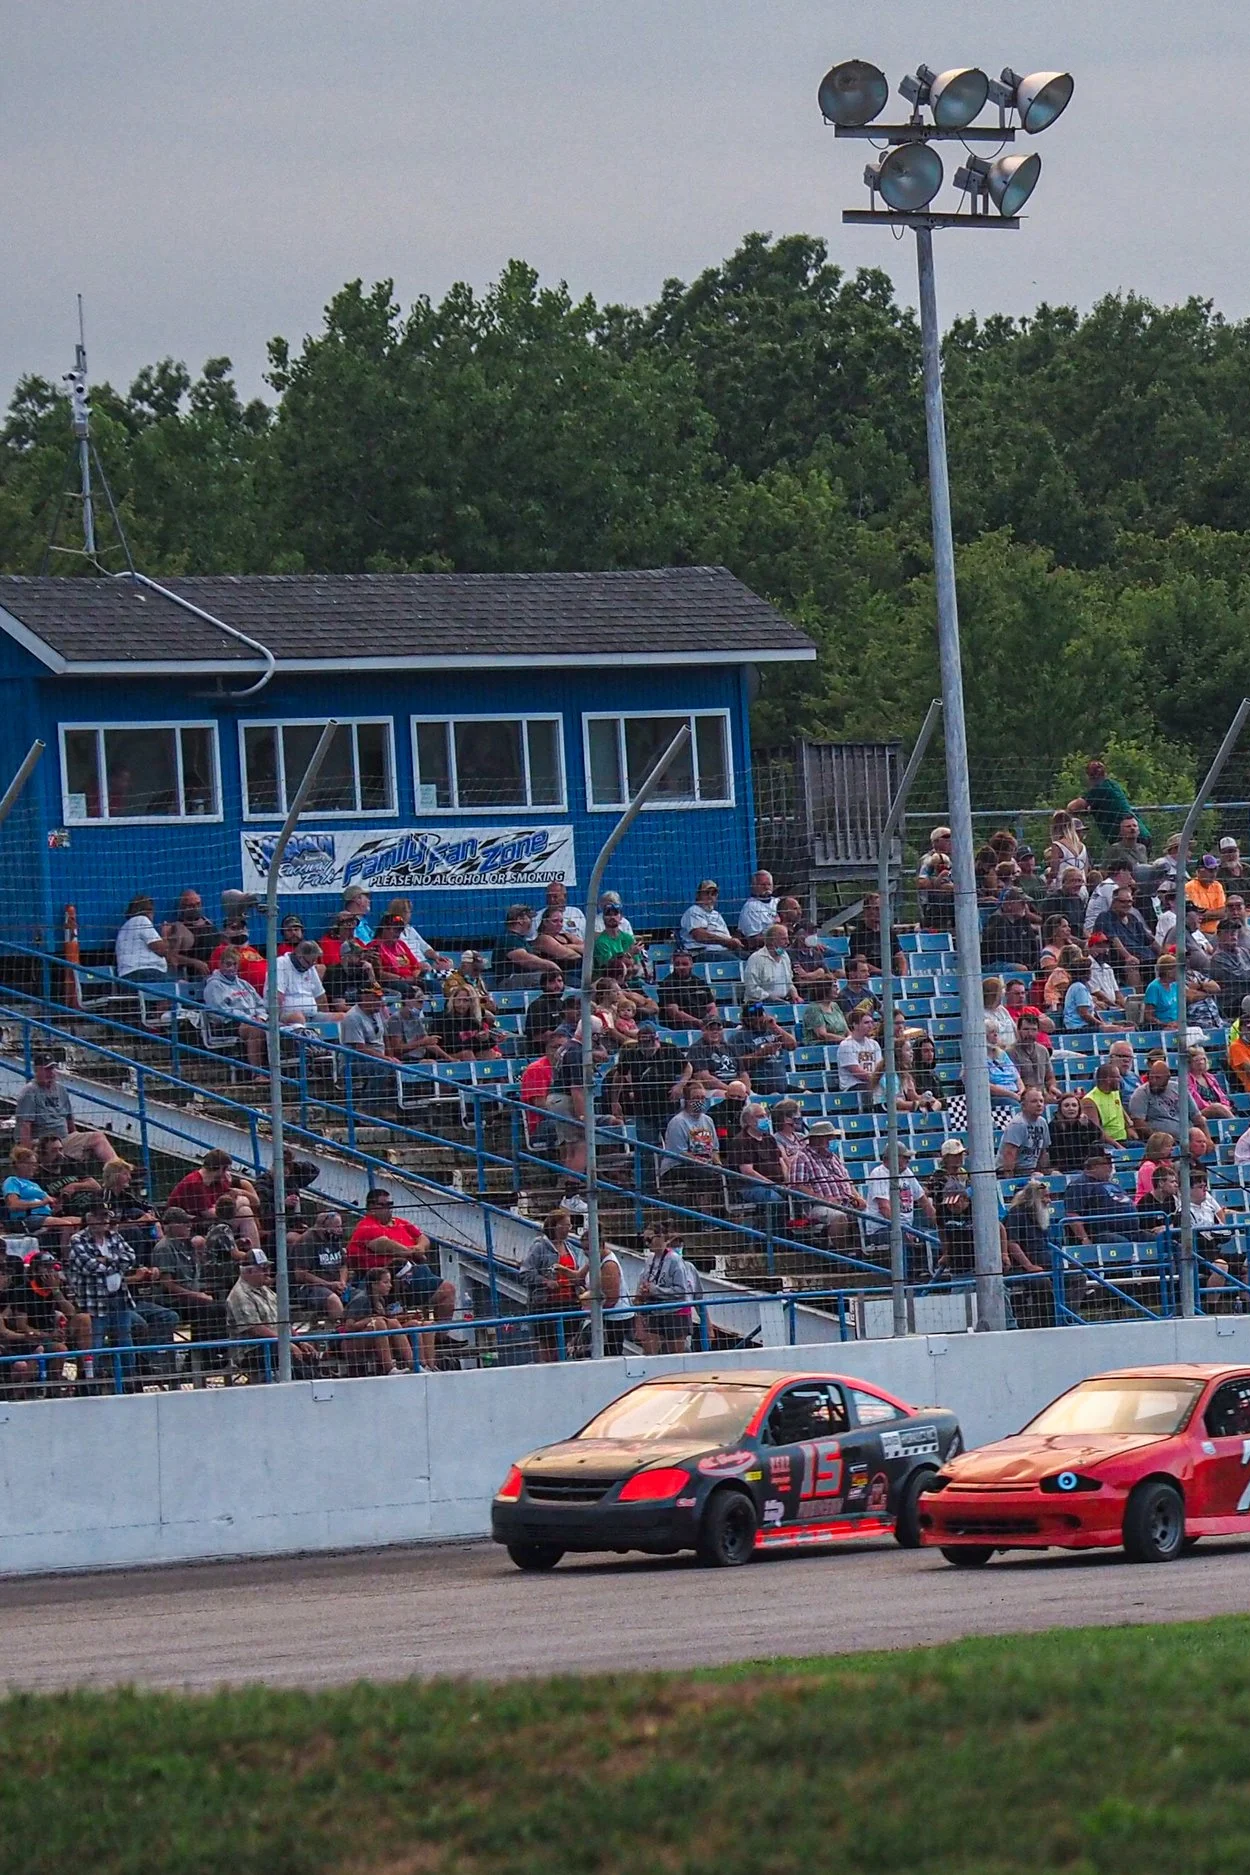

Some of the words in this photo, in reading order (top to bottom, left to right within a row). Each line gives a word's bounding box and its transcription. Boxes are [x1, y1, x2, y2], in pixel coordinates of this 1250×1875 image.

[342, 834, 428, 888] Family
[426, 837, 479, 874] Fan
[478, 830, 549, 874] Zone
[369, 874, 412, 888] PLEASE
[411, 873, 430, 887] NO
[432, 872, 492, 886] ALCOHOL
[491, 872, 506, 885] OR
[510, 871, 565, 884] SMOKING
[800, 1440, 844, 1499] 15
